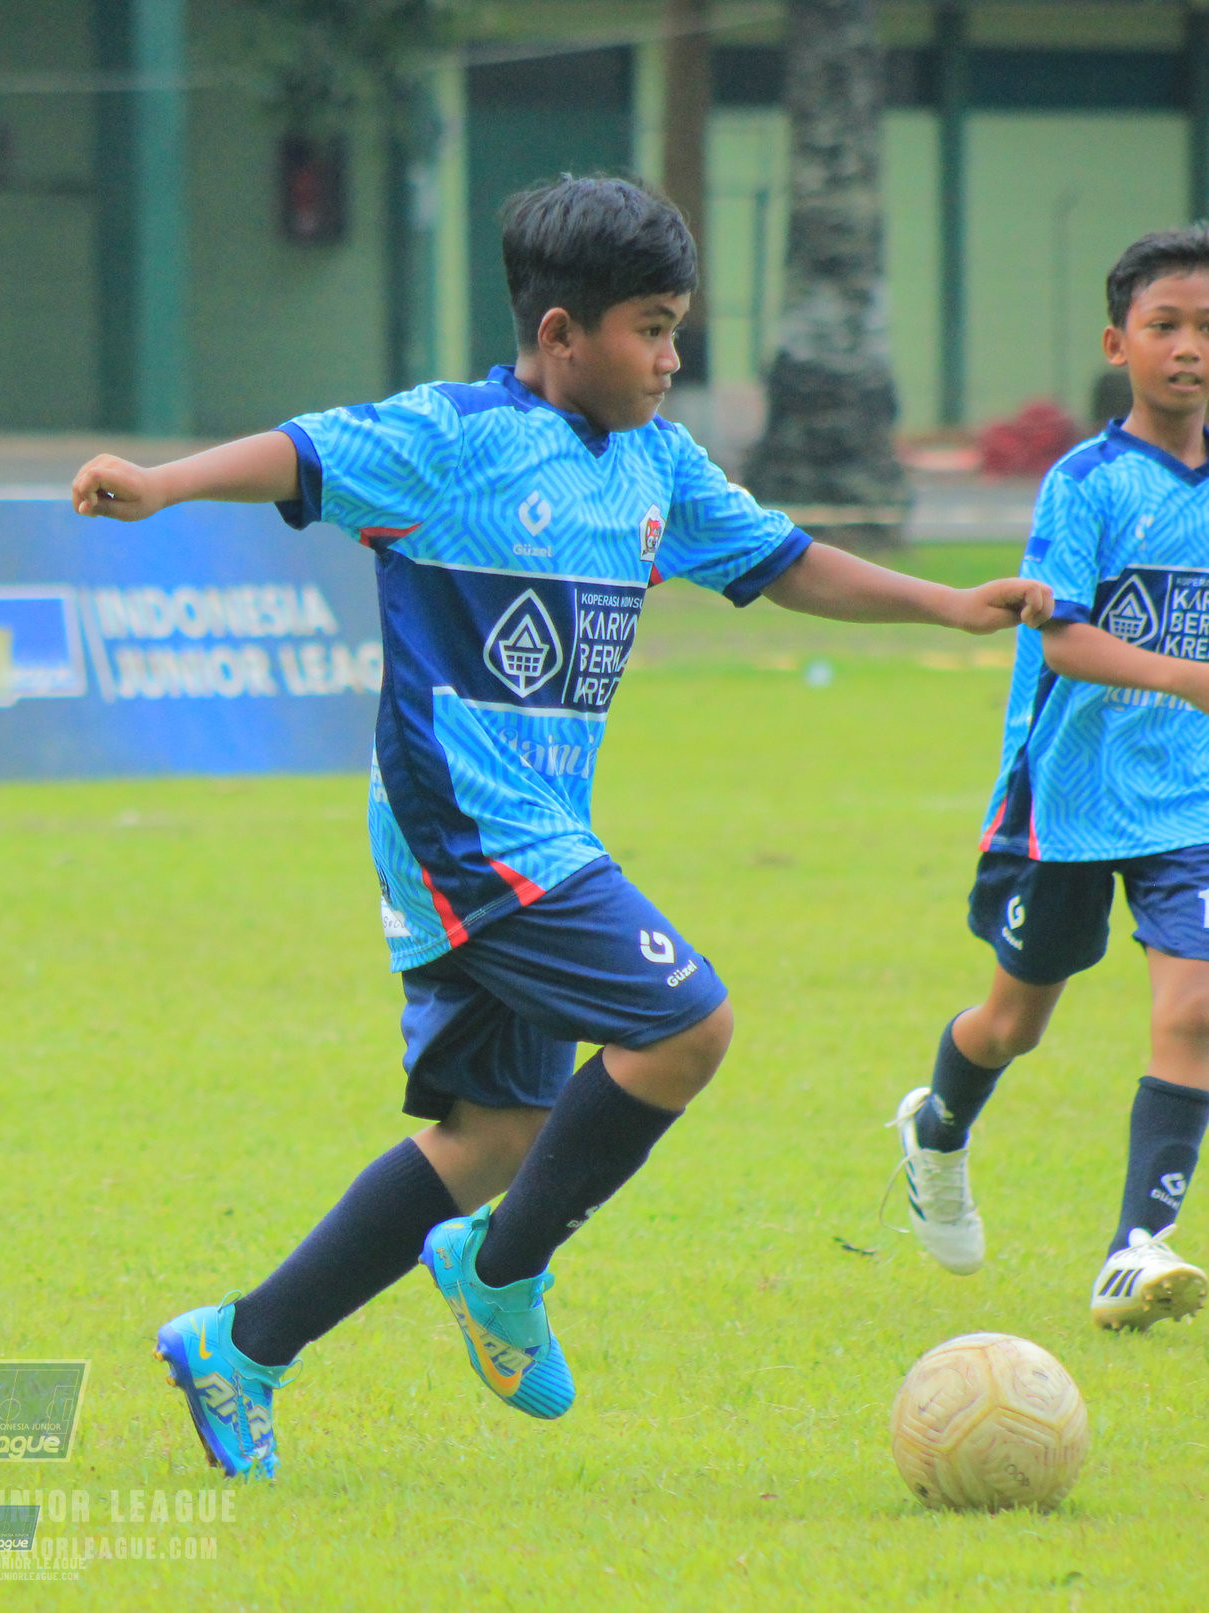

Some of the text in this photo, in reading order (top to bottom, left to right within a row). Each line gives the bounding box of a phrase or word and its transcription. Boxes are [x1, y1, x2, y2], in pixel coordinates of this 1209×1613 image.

[95, 585, 337, 639] INDONESIA
[581, 593, 619, 607] KOPERASI
[115, 643, 277, 698] JUNIOR
